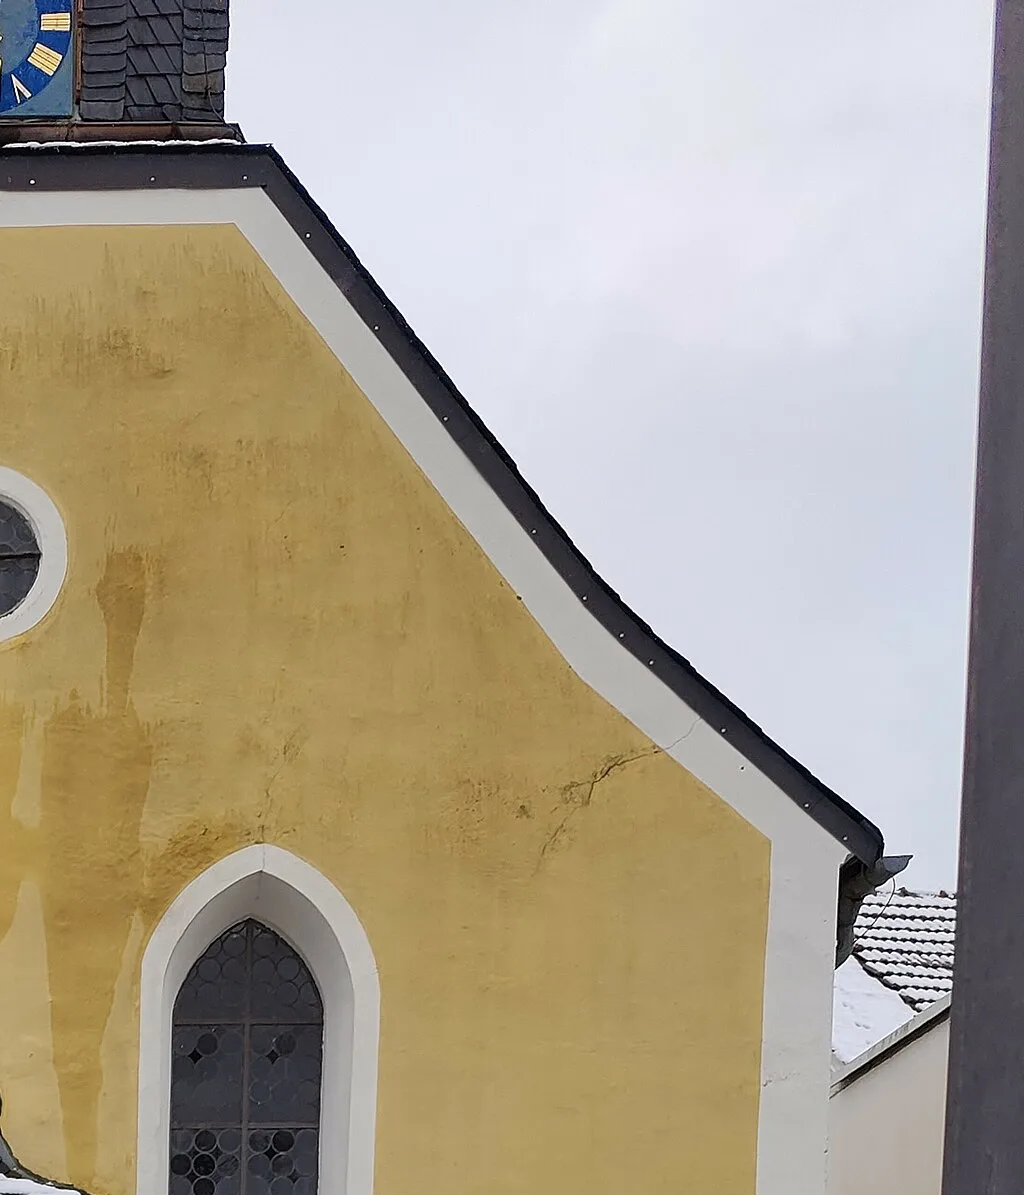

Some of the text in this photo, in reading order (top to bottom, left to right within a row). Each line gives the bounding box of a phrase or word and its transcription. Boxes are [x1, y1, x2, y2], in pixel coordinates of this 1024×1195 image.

[40, 12, 72, 31] III
[27, 42, 64, 77] IIII
[10, 73, 32, 104] V
